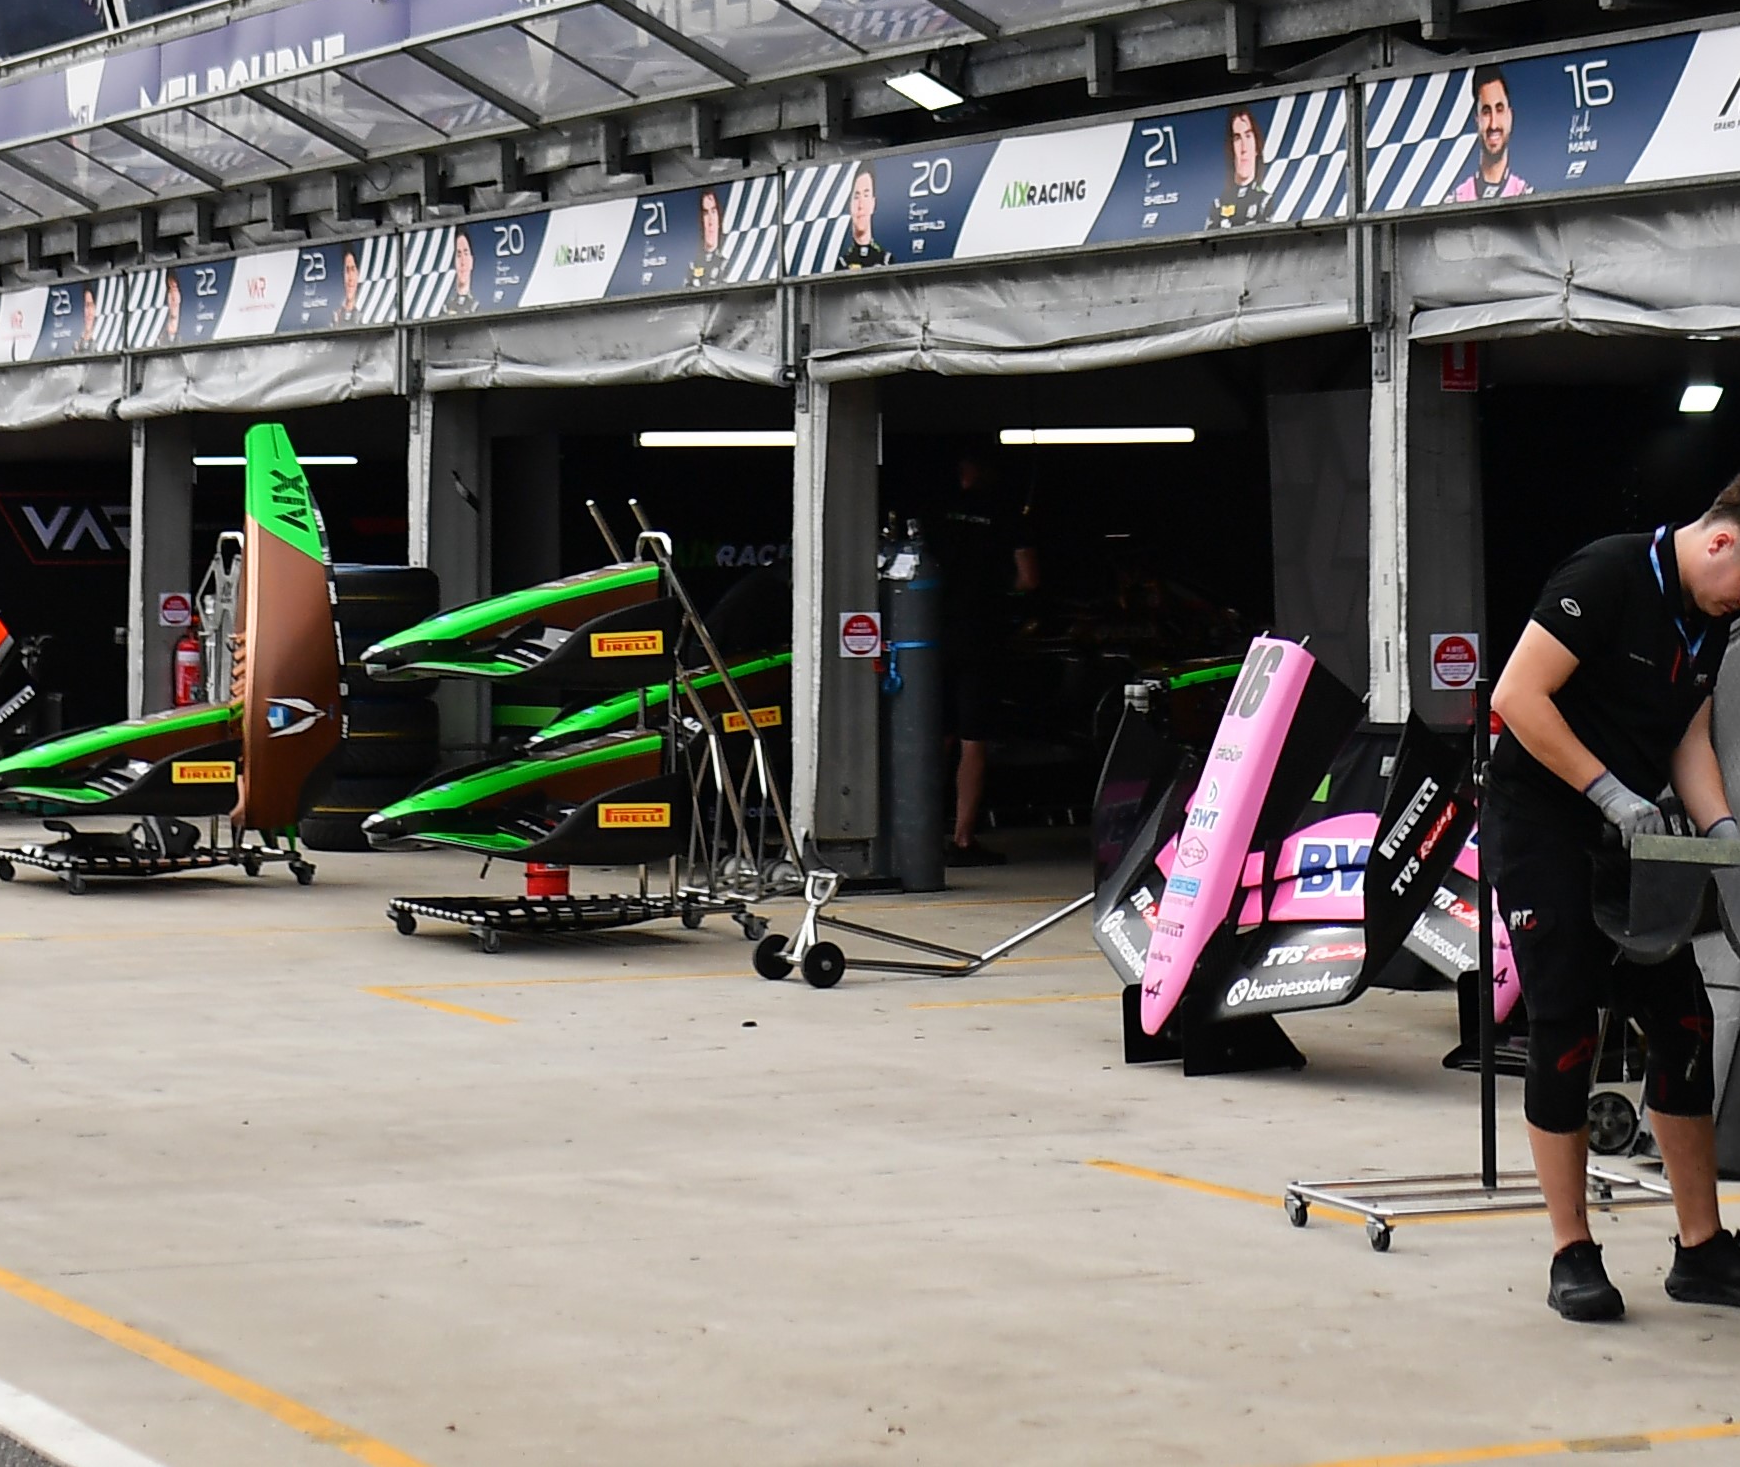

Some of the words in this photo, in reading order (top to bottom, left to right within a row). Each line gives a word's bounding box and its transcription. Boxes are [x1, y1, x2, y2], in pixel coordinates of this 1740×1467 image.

[1564, 60, 1613, 109] 16
[1142, 126, 1177, 167] 21
[1568, 140, 1597, 154] MAINI
[909, 158, 952, 197] 20
[642, 202, 667, 235] 21
[494, 224, 524, 257] 20
[194, 268, 218, 296] 22
[302, 252, 327, 282] 23
[597, 635, 656, 652] PIRELLI
[1227, 645, 1284, 719] 16
[605, 808, 664, 823] PIRELLI
[1190, 807, 1219, 830] BWT
[1378, 776, 1439, 860] PIRELLI
[1391, 856, 1420, 897] TVS
[1263, 944, 1309, 967] TVS
[1247, 970, 1351, 1002] businessolver
